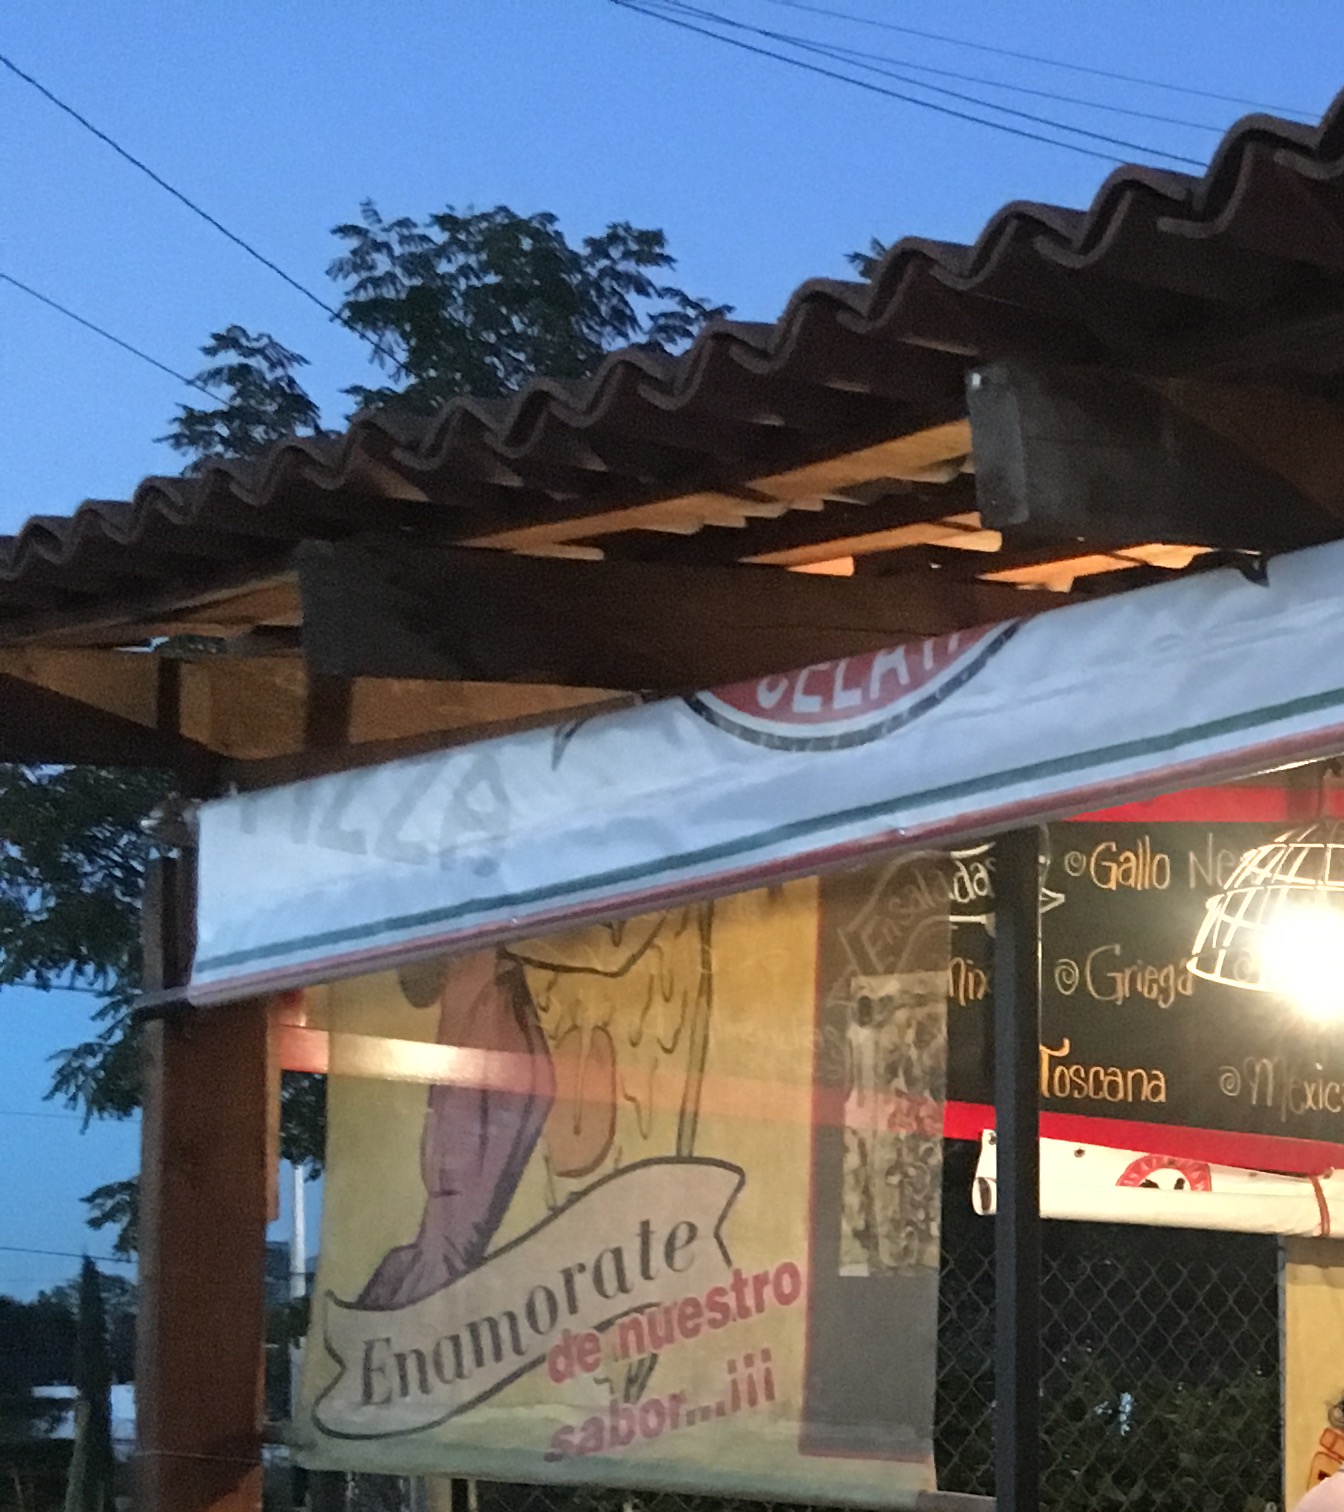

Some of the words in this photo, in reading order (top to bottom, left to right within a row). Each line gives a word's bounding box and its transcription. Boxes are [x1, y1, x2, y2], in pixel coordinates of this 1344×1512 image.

[1089, 834, 1170, 891] Gallo
[1086, 944, 1196, 1010] Griega
[359, 1219, 700, 1409] Enamorate
[546, 1327, 602, 1384] de
[618, 1260, 803, 1360] nuestro
